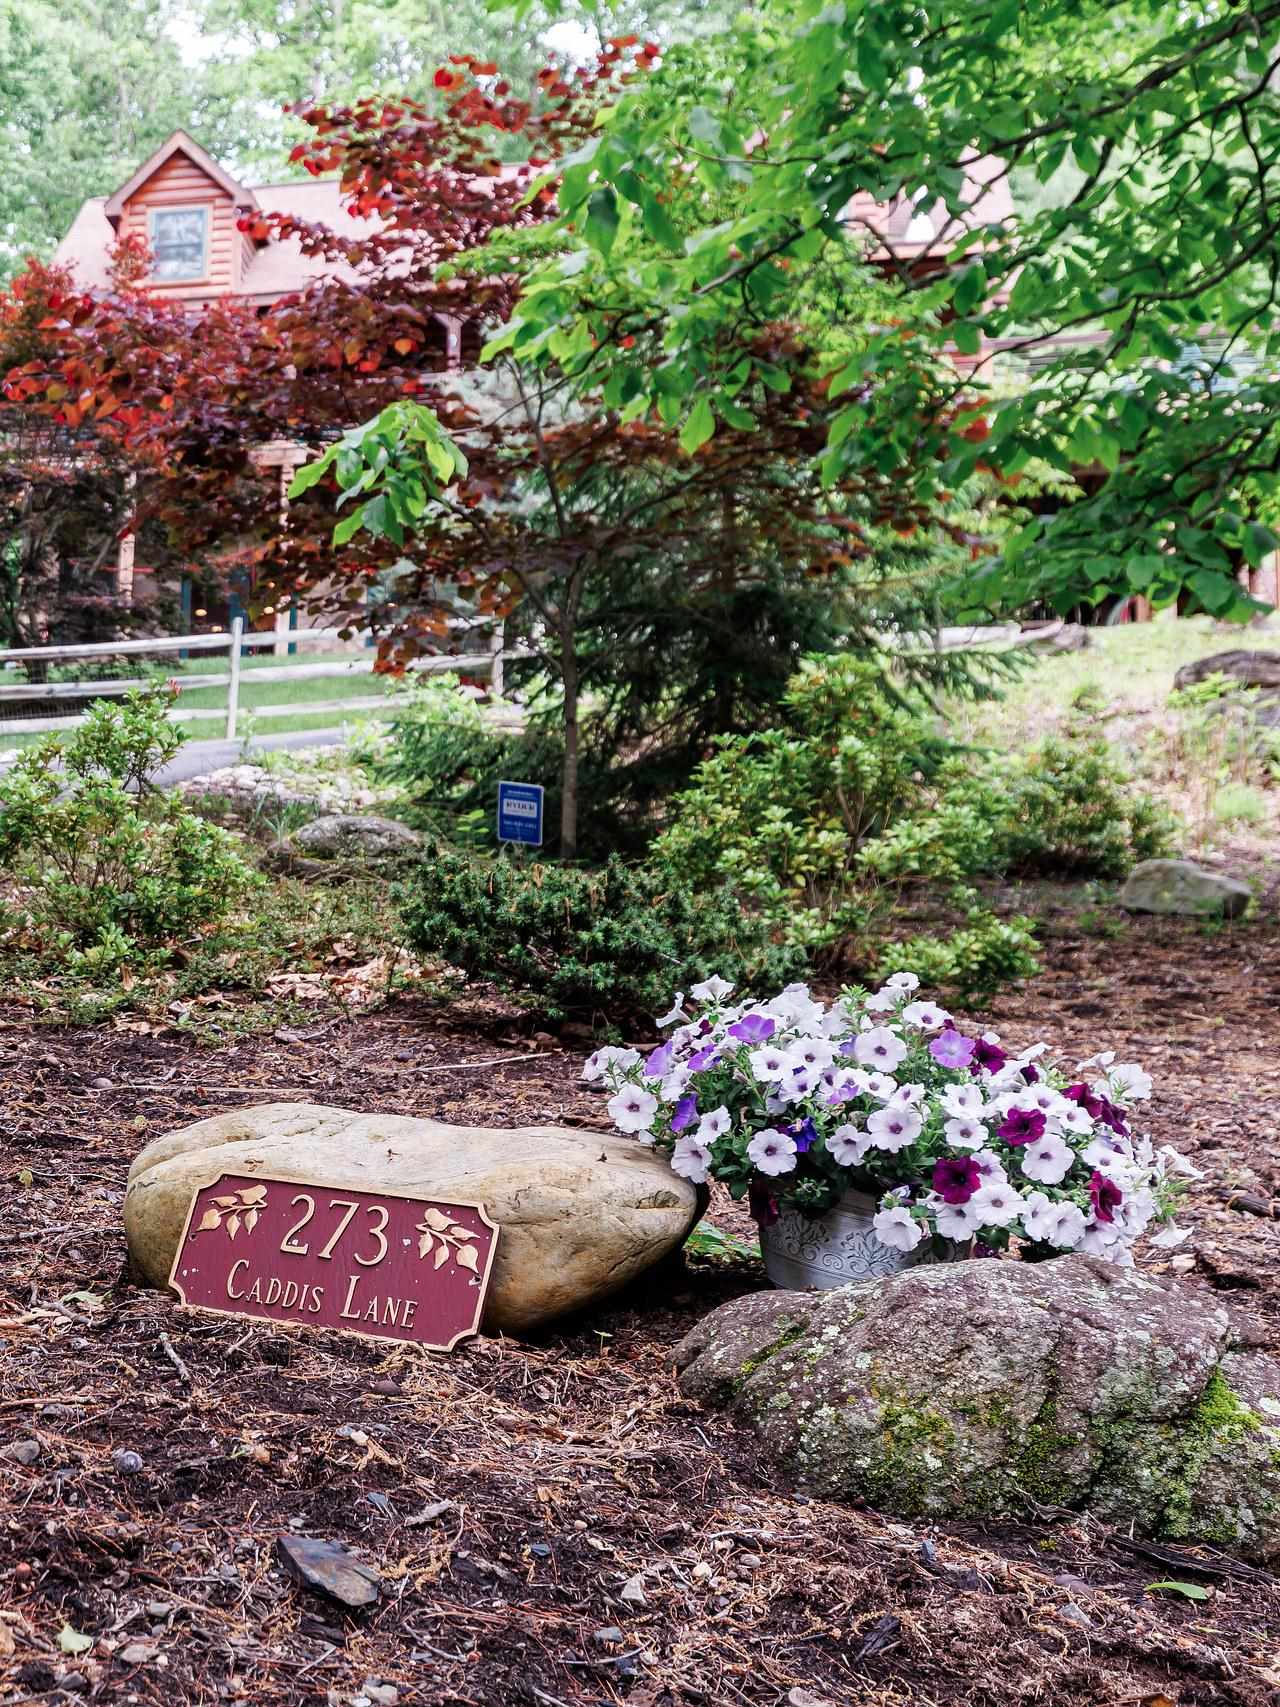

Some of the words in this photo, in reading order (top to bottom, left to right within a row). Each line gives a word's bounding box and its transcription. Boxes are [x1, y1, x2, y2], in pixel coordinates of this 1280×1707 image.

[280, 1194, 390, 1266] 273
[227, 1259, 324, 1313] CADDIS
[340, 1275, 418, 1328] LANE
